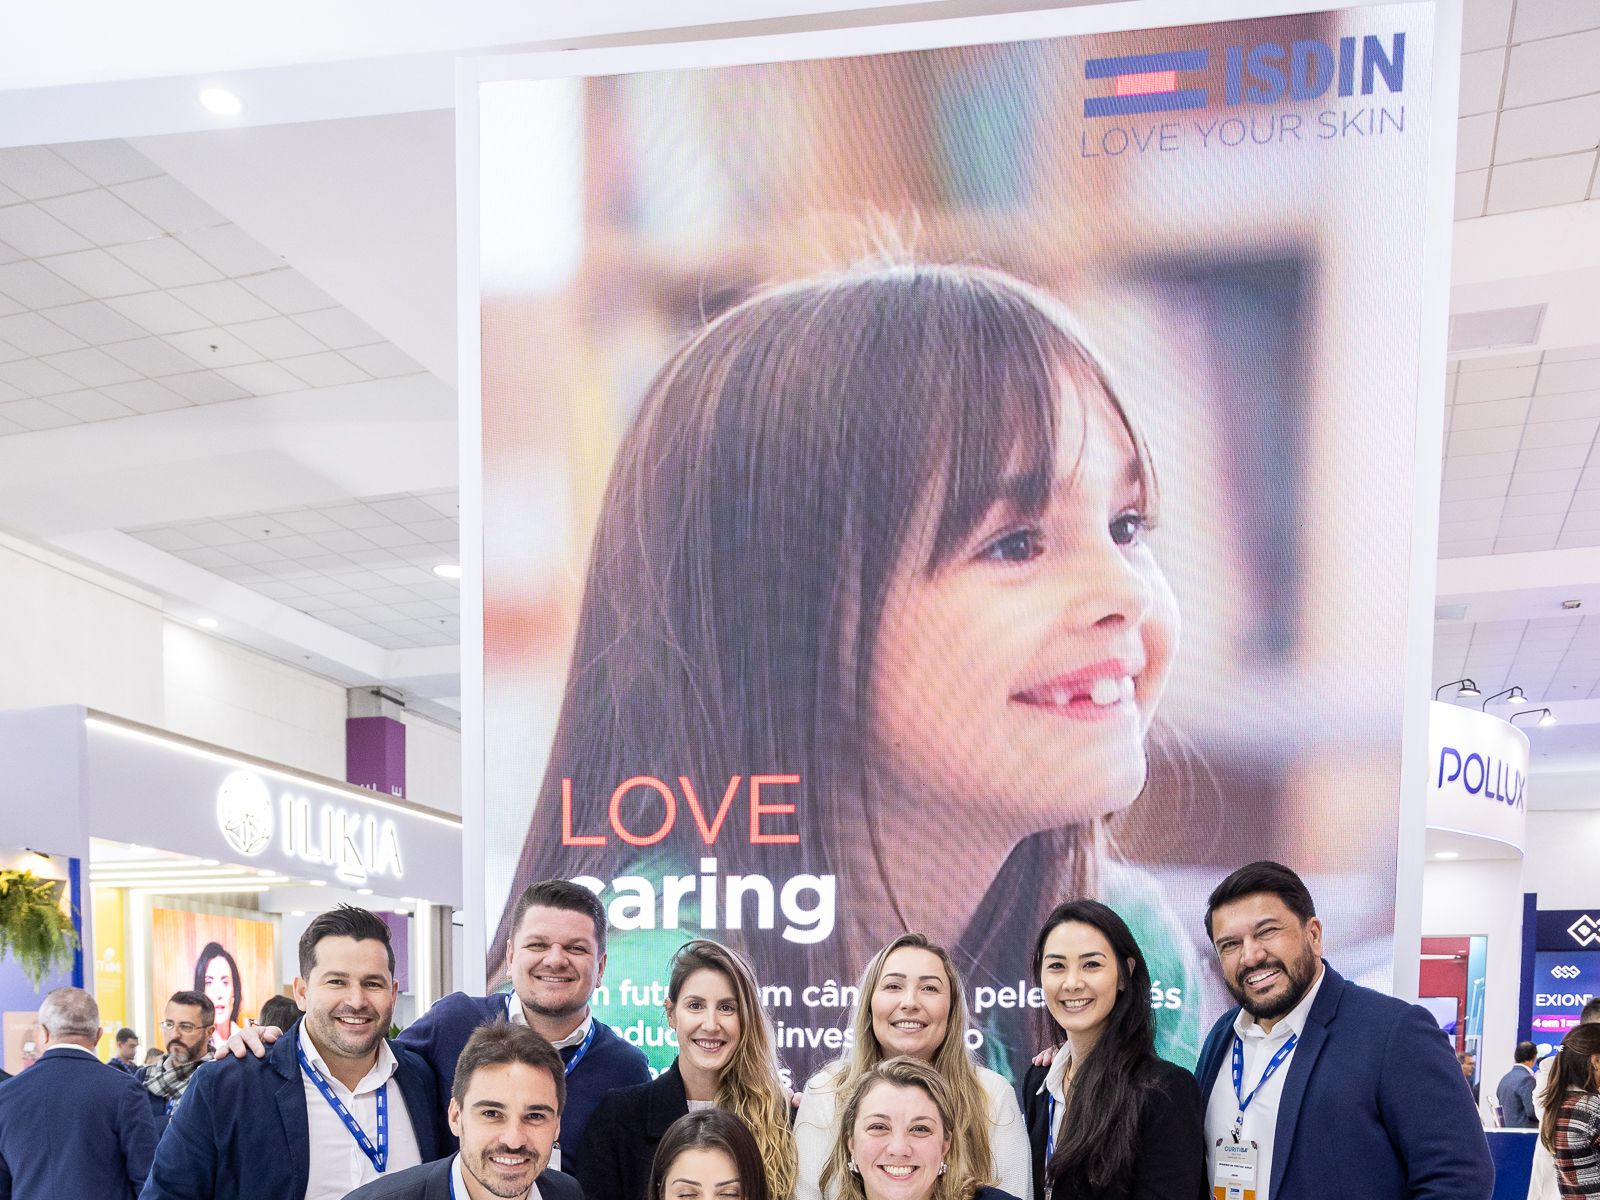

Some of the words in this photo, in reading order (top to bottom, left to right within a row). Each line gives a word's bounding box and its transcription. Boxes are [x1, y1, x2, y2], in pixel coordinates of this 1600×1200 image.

[1225, 32, 1406, 107] ISDIN
[1081, 123, 1181, 159] LOVE
[1194, 113, 1302, 147] YOUR
[1317, 105, 1405, 140] SKIN
[561, 774, 801, 846] LOVE
[1438, 746, 1526, 814] POLLUX
[281, 794, 404, 881] ILIKIA
[619, 978, 669, 1007] fut
[801, 979, 860, 1008] cân
[777, 1020, 856, 1049] inves
